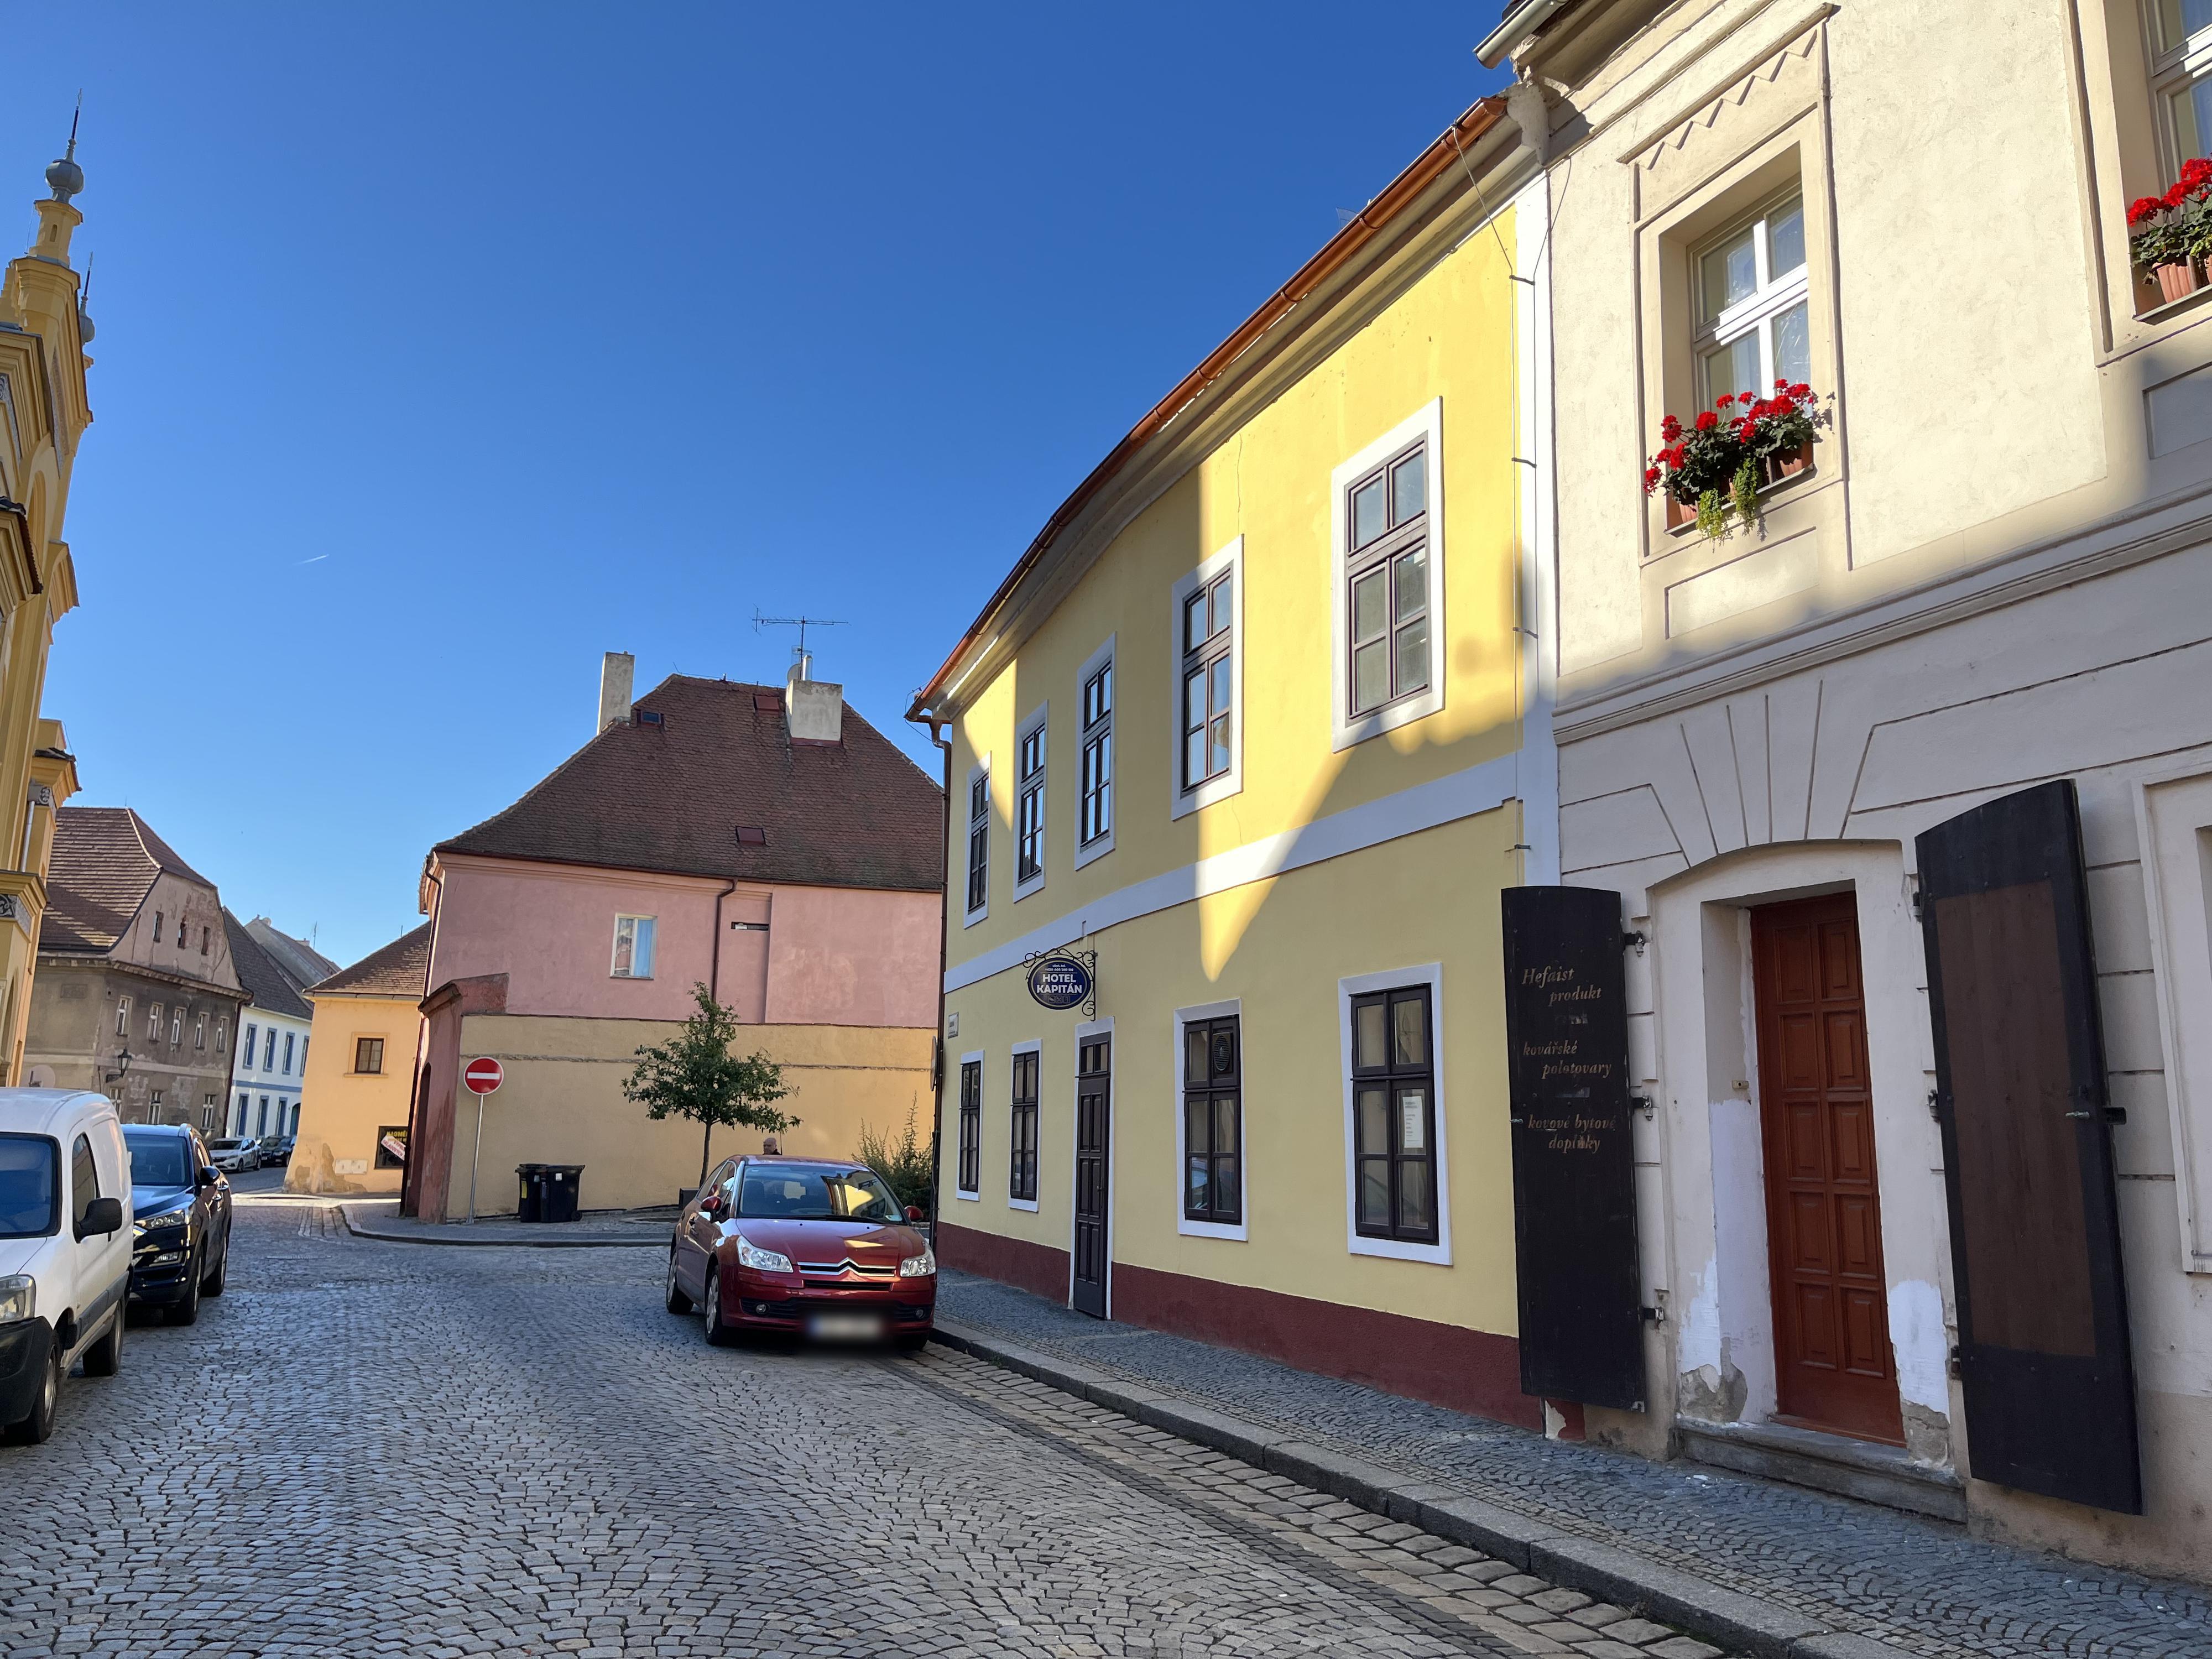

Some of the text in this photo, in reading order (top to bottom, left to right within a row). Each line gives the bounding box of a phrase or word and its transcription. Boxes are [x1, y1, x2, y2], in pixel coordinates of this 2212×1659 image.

[1043, 974, 1076, 982] HOTEL
[1521, 966, 1575, 988] Hefaist
[1037, 983, 1082, 993] KAPITÁN
[1547, 984, 1602, 1007] produkt
[1523, 1040, 1578, 1056] kovářské
[1528, 1114, 1617, 1133] kovové bytové
[1548, 1133, 1601, 1154] doplňky
